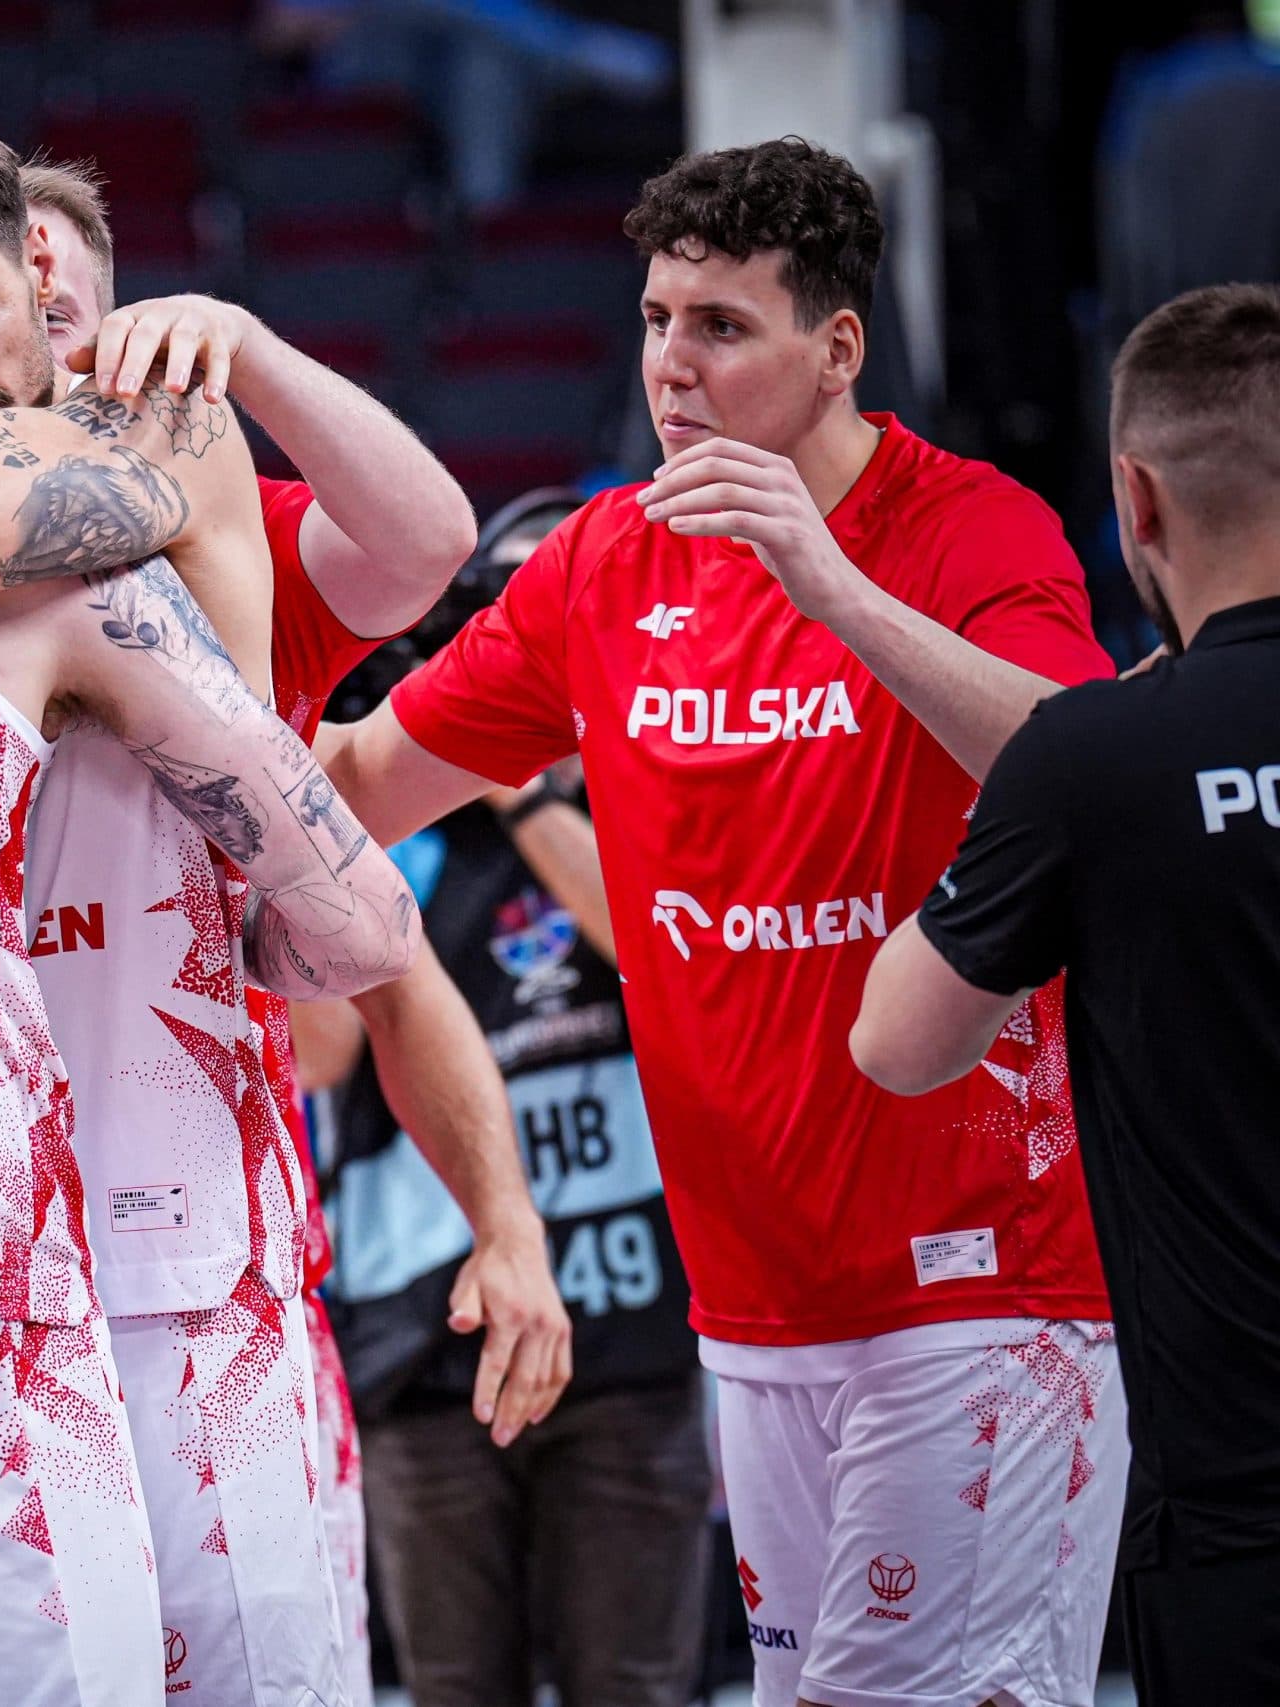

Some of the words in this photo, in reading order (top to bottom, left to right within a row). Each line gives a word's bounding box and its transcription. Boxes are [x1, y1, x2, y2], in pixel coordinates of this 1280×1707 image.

[635, 603, 696, 640] 4F
[627, 680, 861, 745] POLSKA
[723, 892, 888, 952] ORLEN
[548, 1211, 663, 1317] 49
[866, 1607, 911, 1621] PZKOSZ
